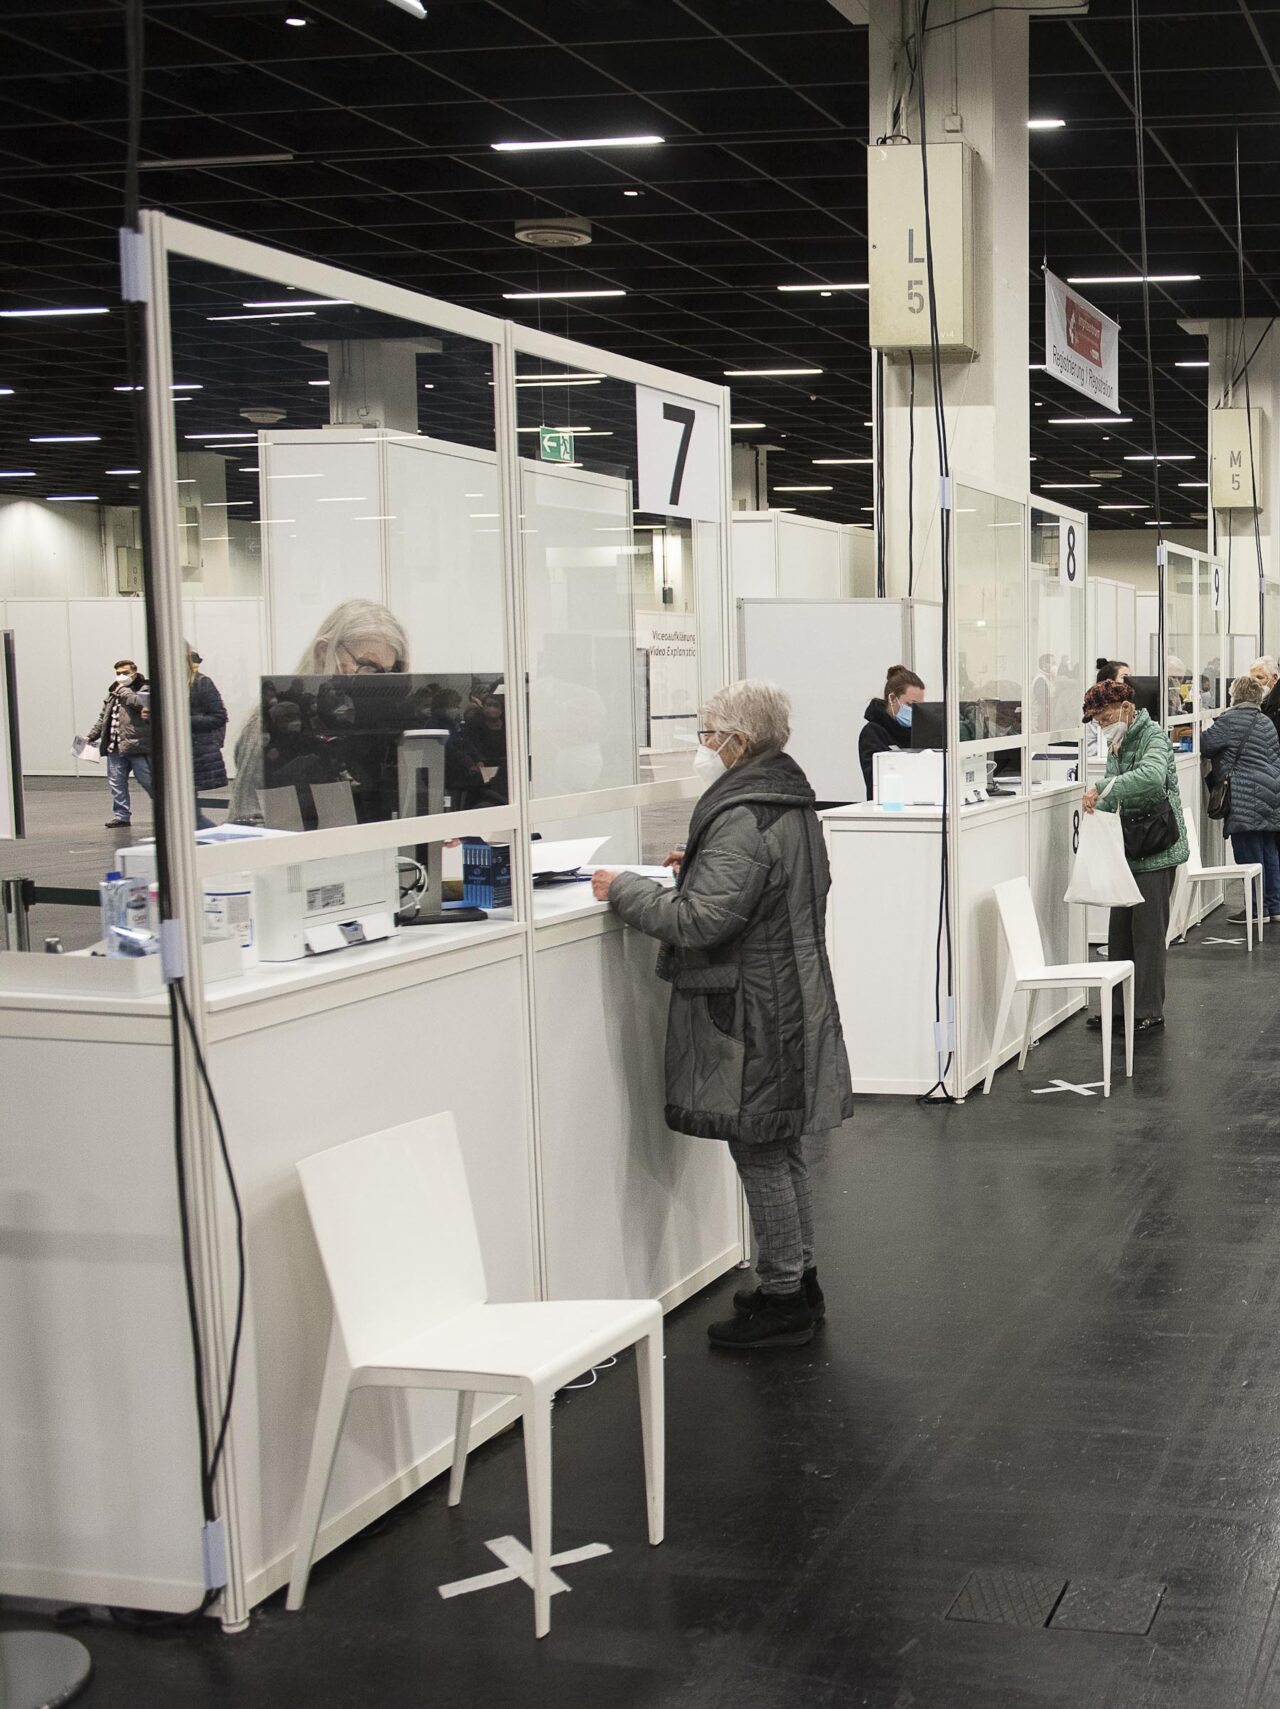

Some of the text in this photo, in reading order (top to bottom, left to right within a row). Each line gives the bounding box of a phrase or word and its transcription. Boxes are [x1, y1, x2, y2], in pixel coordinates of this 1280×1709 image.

[908, 228, 925, 264] L
[907, 280, 925, 314] 5
[1052, 344, 1084, 386] Registrierung
[1088, 368, 1113, 399] Registration
[662, 401, 696, 507] 7
[1229, 449, 1242, 468] M
[1231, 473, 1241, 491] 5
[1066, 525, 1076, 582] 8
[1214, 567, 1220, 607] 9
[1072, 809, 1080, 855] 8
